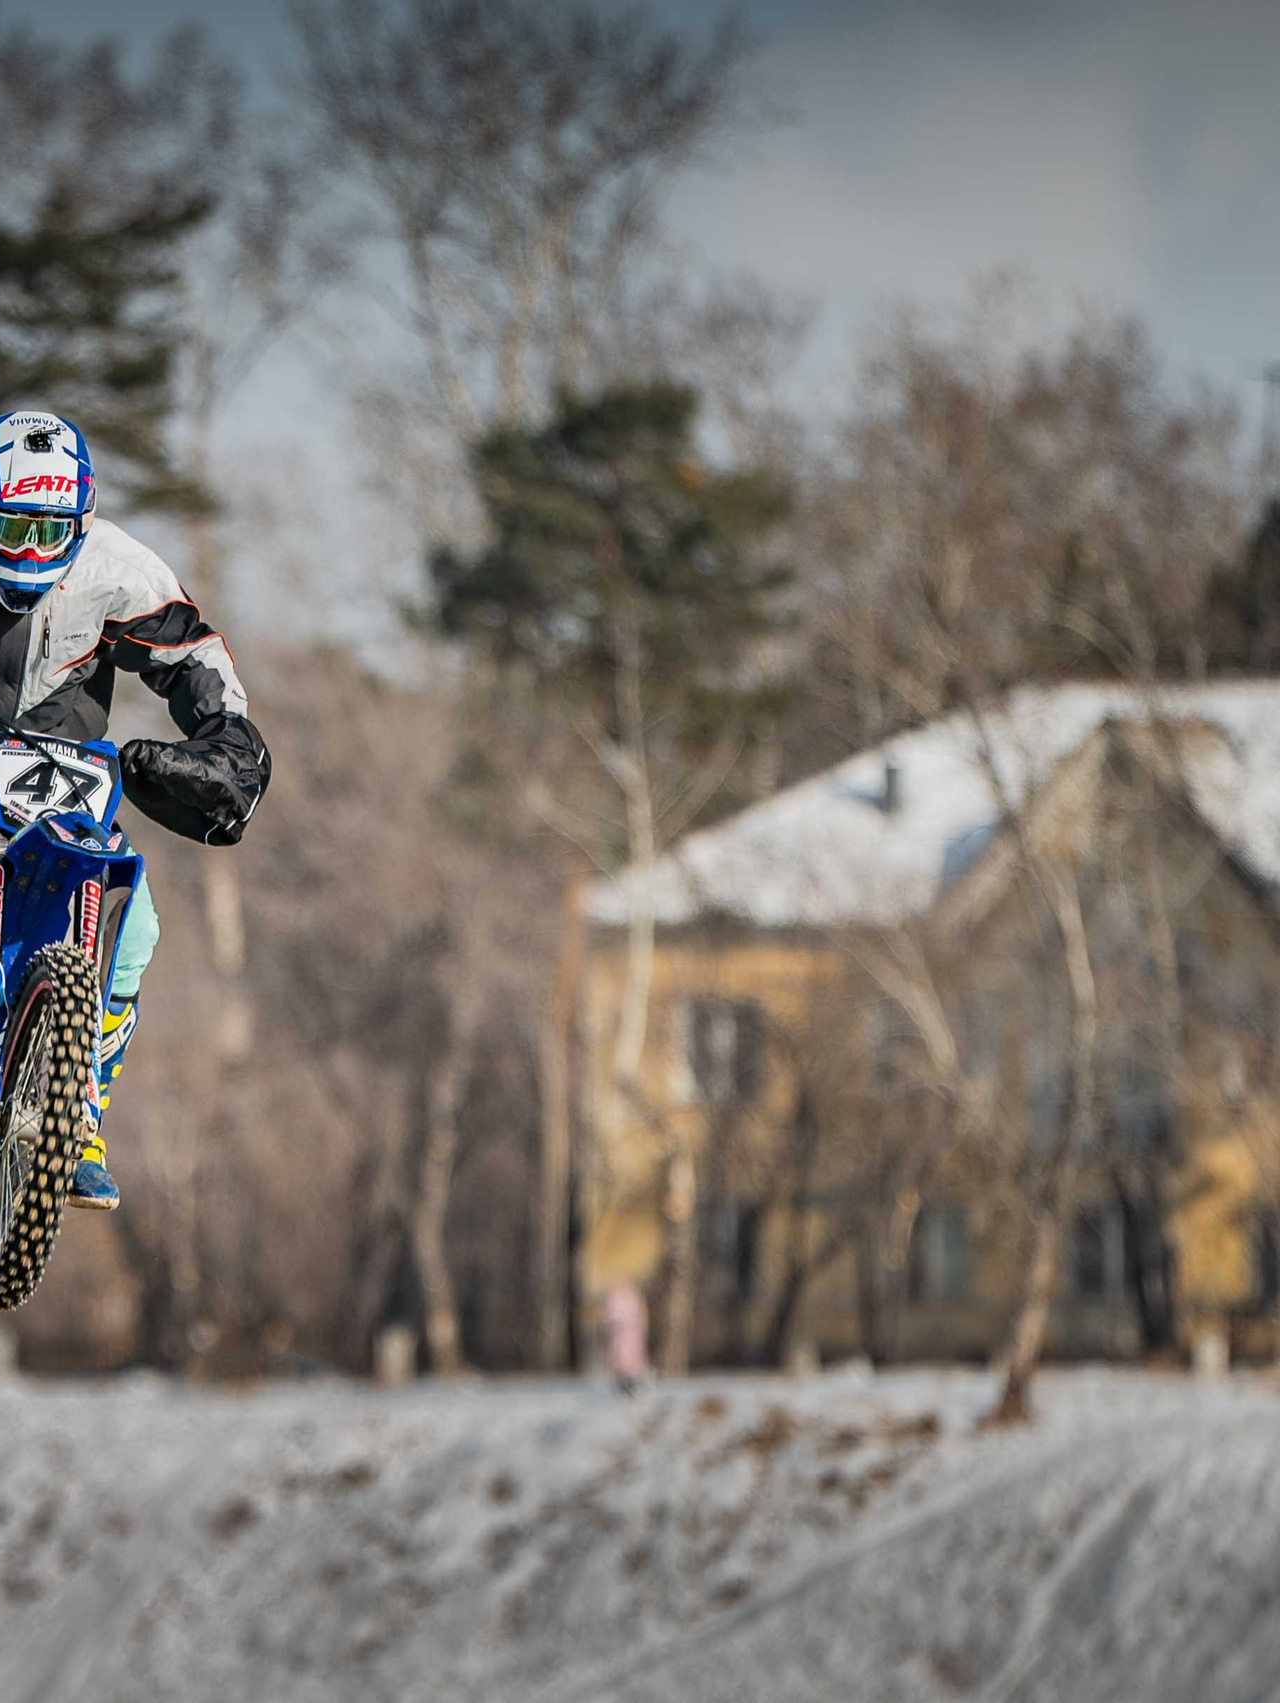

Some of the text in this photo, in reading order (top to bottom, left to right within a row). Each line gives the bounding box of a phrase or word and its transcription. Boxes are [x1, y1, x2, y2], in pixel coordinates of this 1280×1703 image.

[8, 417, 55, 427] YAMAHA
[37, 741, 78, 760] AMAHA
[5, 759, 104, 811] 47
